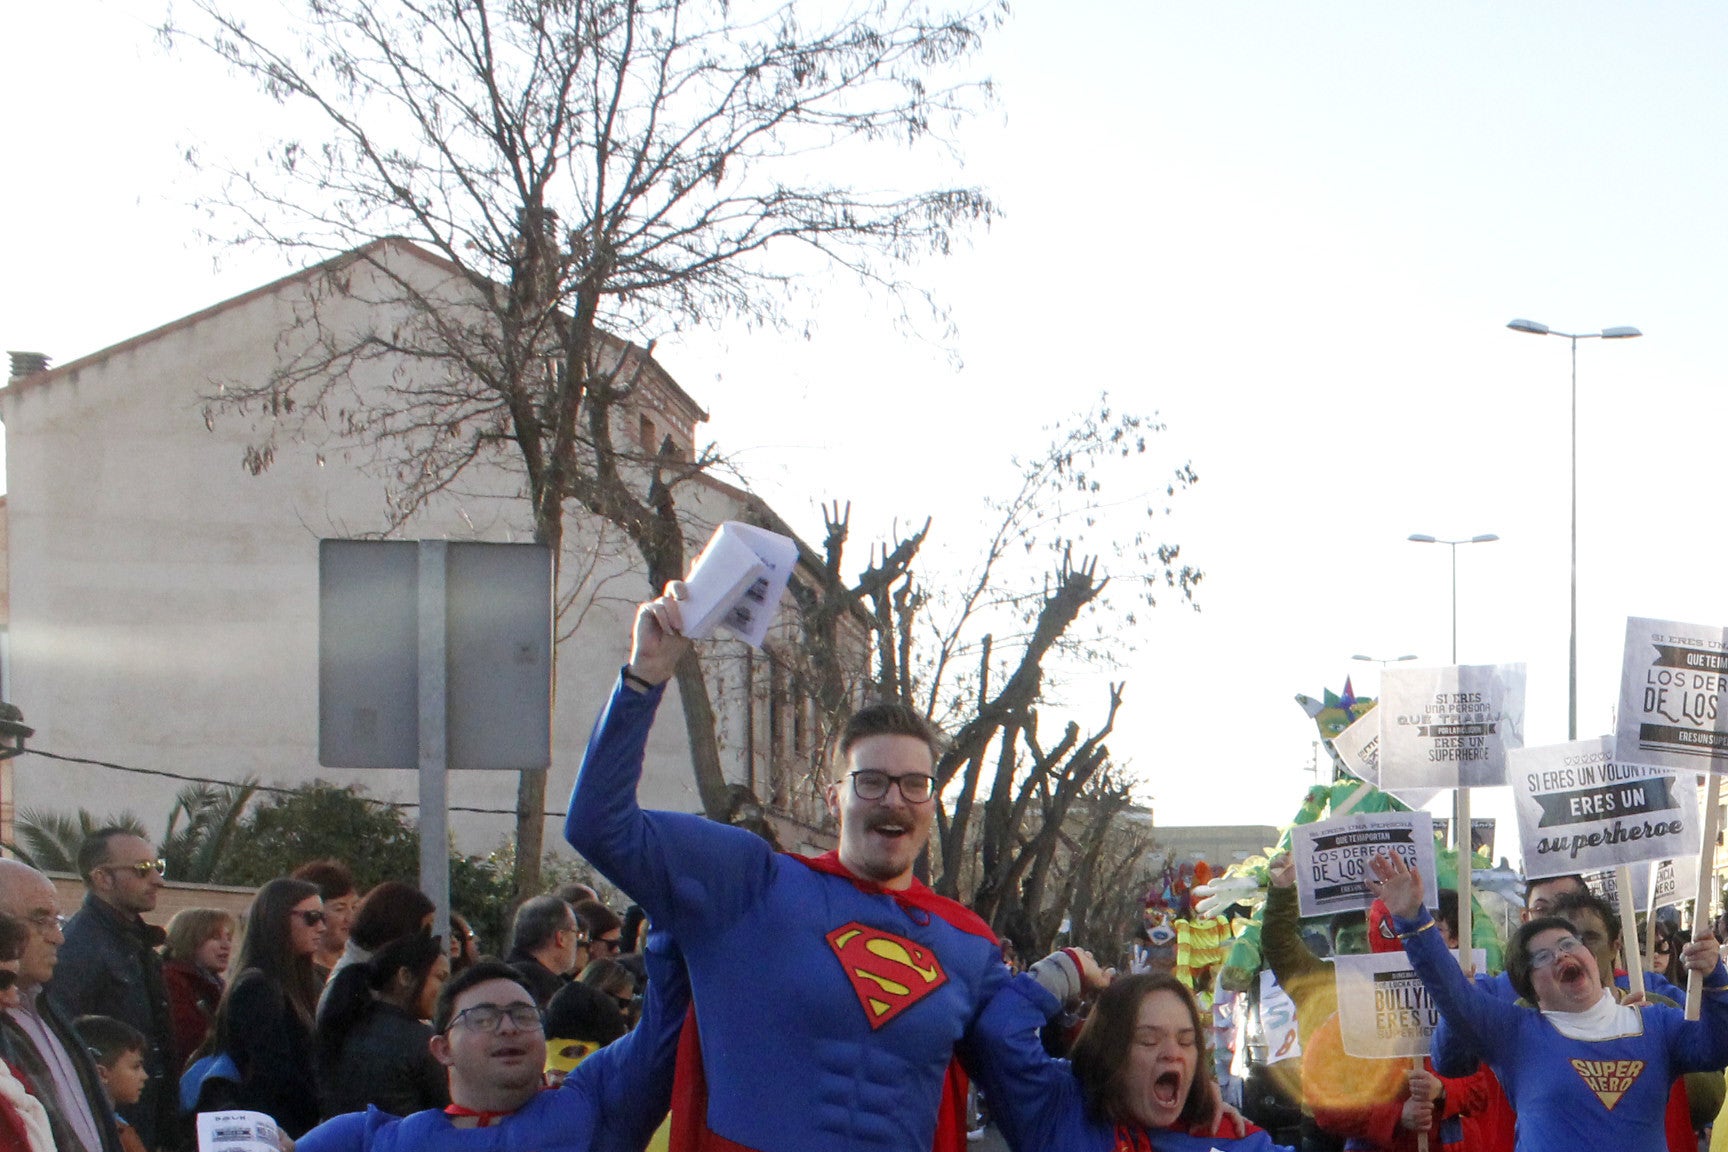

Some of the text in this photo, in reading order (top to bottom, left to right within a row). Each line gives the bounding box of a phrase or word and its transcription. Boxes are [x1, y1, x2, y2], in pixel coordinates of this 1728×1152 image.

[1652, 633, 1665, 642] SI
[1669, 635, 1704, 648] ERES
[1647, 669, 1686, 688] LOS
[1436, 692, 1482, 704] SI ERES
[1643, 687, 1680, 724] DE
[1682, 691, 1719, 726] LOS
[1439, 711, 1502, 724] TRABAJ
[1434, 736, 1485, 748] ERES UN
[1527, 763, 1677, 793] SI ERES UN VOLUN
[1570, 787, 1647, 817] ERES UN
[1537, 819, 1684, 859] superheroe
[1311, 851, 1338, 865] LOS
[1312, 864, 1340, 883] DE
[1339, 859, 1366, 880] LOS
[1375, 987, 1434, 1011] BULLYI
[1376, 1009, 1438, 1030] ERES U
[1376, 1026, 1435, 1040] SUPERHE
[1571, 1059, 1644, 1078] SUPER
[1584, 1077, 1633, 1092] HERO
